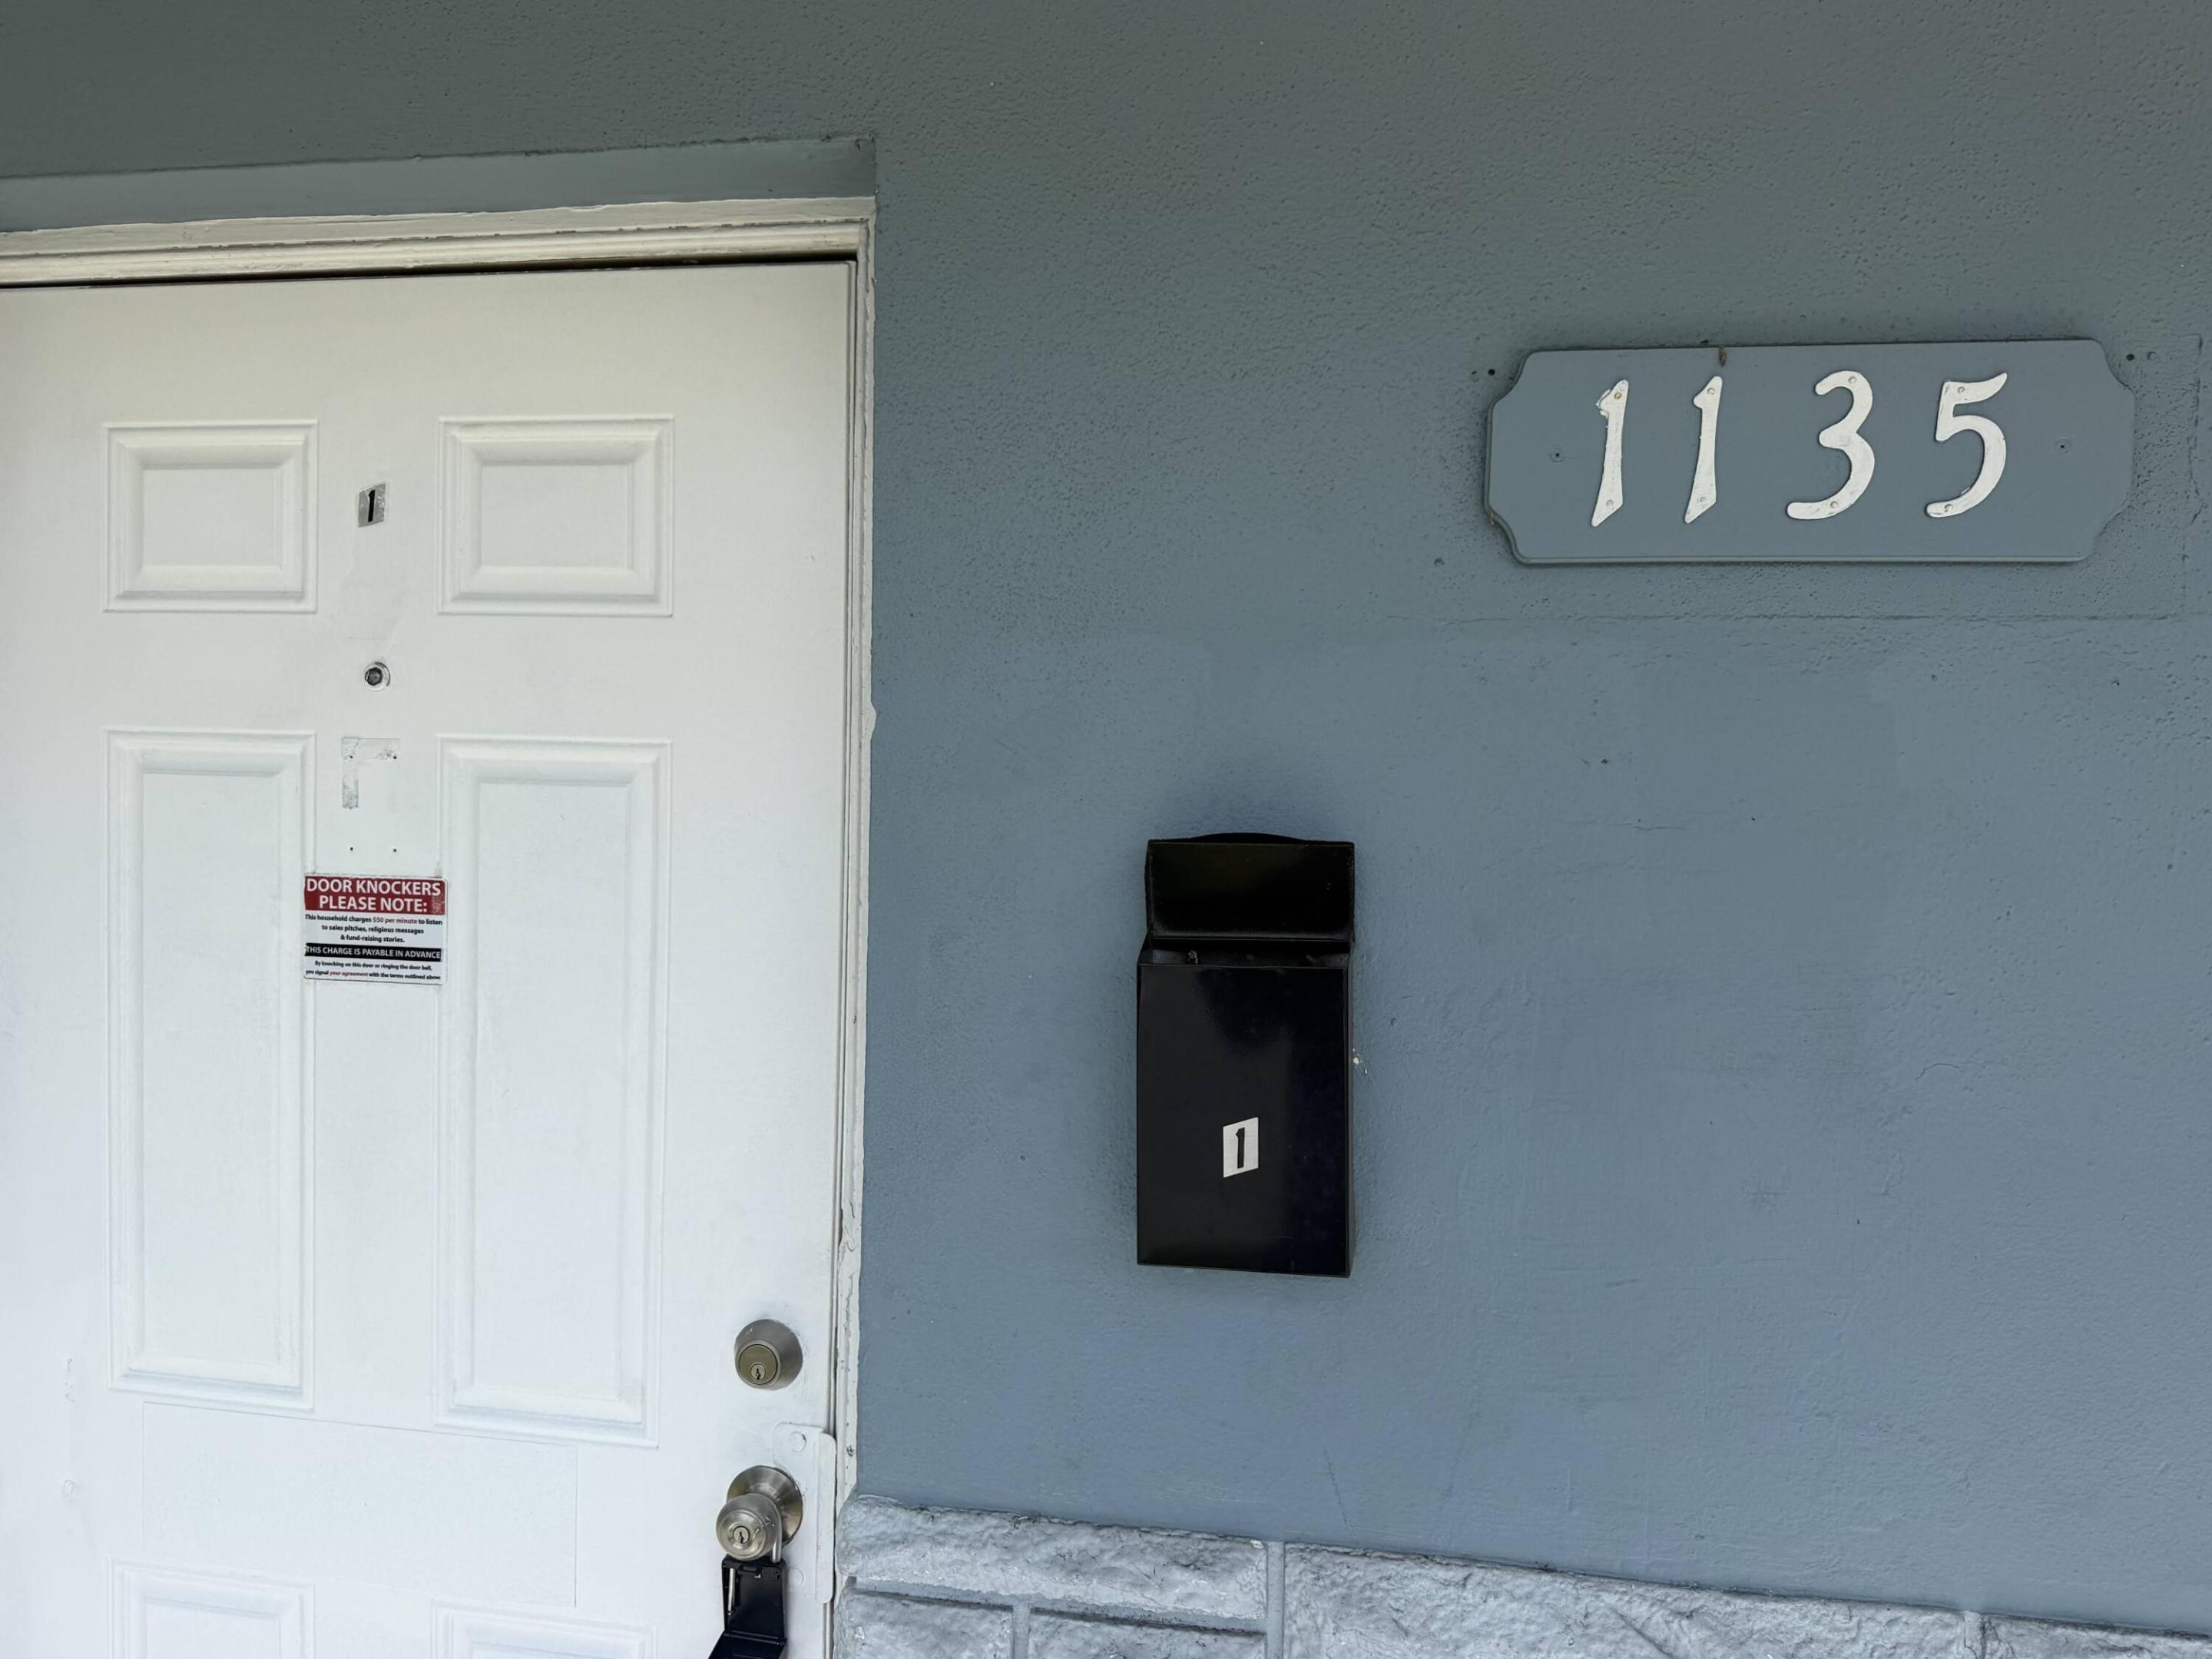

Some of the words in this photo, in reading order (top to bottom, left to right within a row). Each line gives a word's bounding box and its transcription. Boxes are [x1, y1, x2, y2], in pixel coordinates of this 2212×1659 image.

[1591, 370, 2008, 527] 1135
[368, 490, 376, 522] 1
[307, 879, 353, 893] DOOR
[356, 880, 441, 896] KNOCKERS
[320, 896, 376, 910] PLEASE
[381, 898, 427, 912] NOTE:
[406, 950, 441, 959] ADVANCE
[1235, 1128, 1245, 1169] 1
